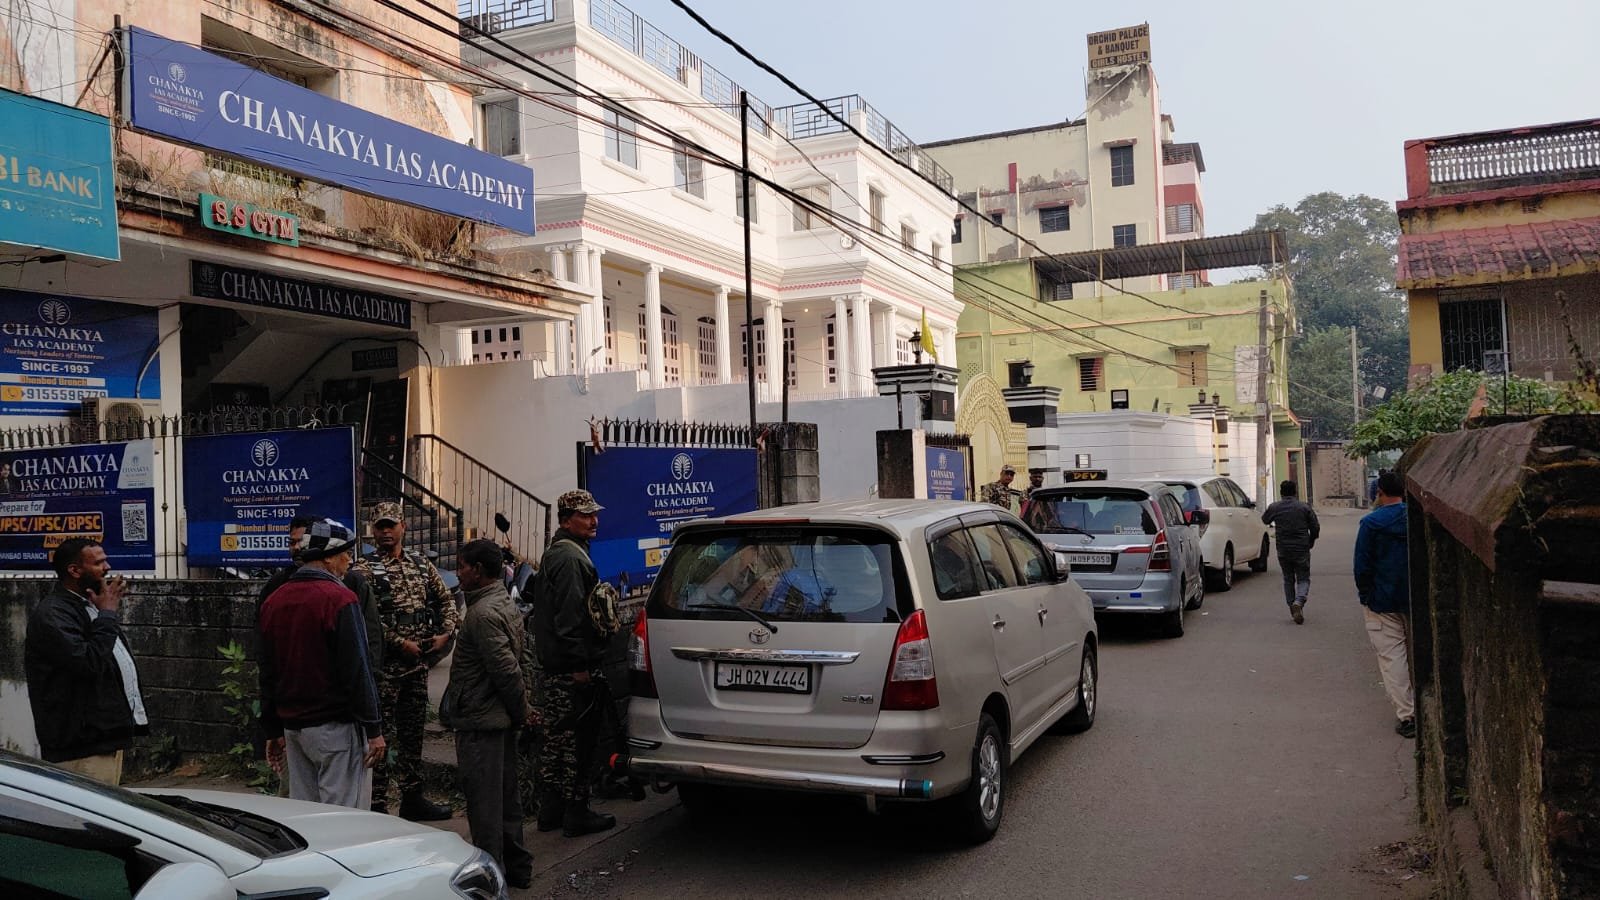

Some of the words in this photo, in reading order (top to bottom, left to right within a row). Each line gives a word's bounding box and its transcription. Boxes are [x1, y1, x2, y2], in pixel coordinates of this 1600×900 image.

[1088, 33, 1117, 45] ORCHID
[1119, 26, 1148, 40] PALACE
[1105, 40, 1140, 54] BANQUET
[148, 75, 204, 100] CHANAKYA
[218, 90, 381, 168] CHANAKYA
[384, 142, 423, 180] IAS
[426, 159, 526, 211] ACADEMY
[27, 165, 94, 199] BANK
[250, 210, 295, 241] GYM
[220, 271, 315, 310] CHANAKYA
[318, 288, 342, 314] IAS
[343, 294, 407, 325] ACADEMY
[2, 323, 104, 343] CHANAKYA
[13, 338, 34, 348] IAS
[36, 340, 96, 353] ACADEMY
[21, 361, 90, 374] SINCE-1993
[12, 453, 119, 478] CHANAKYA
[222, 467, 310, 483] CHANAKYA
[1073, 472, 1098, 480] DEV
[20, 478, 40, 492] IAS
[43, 475, 107, 491] ACADEMY
[231, 485, 247, 495] IAS
[249, 484, 302, 494] ACADEMY
[646, 481, 715, 496] CHANAKYA
[30, 501, 43, 511] for
[654, 499, 669, 508] IAS
[669, 496, 709, 507] ACADEMY
[237, 508, 296, 519] SINCE-1993
[726, 669, 742, 684] JH
[745, 669, 770, 685] 02V
[773, 670, 805, 687] 4444
